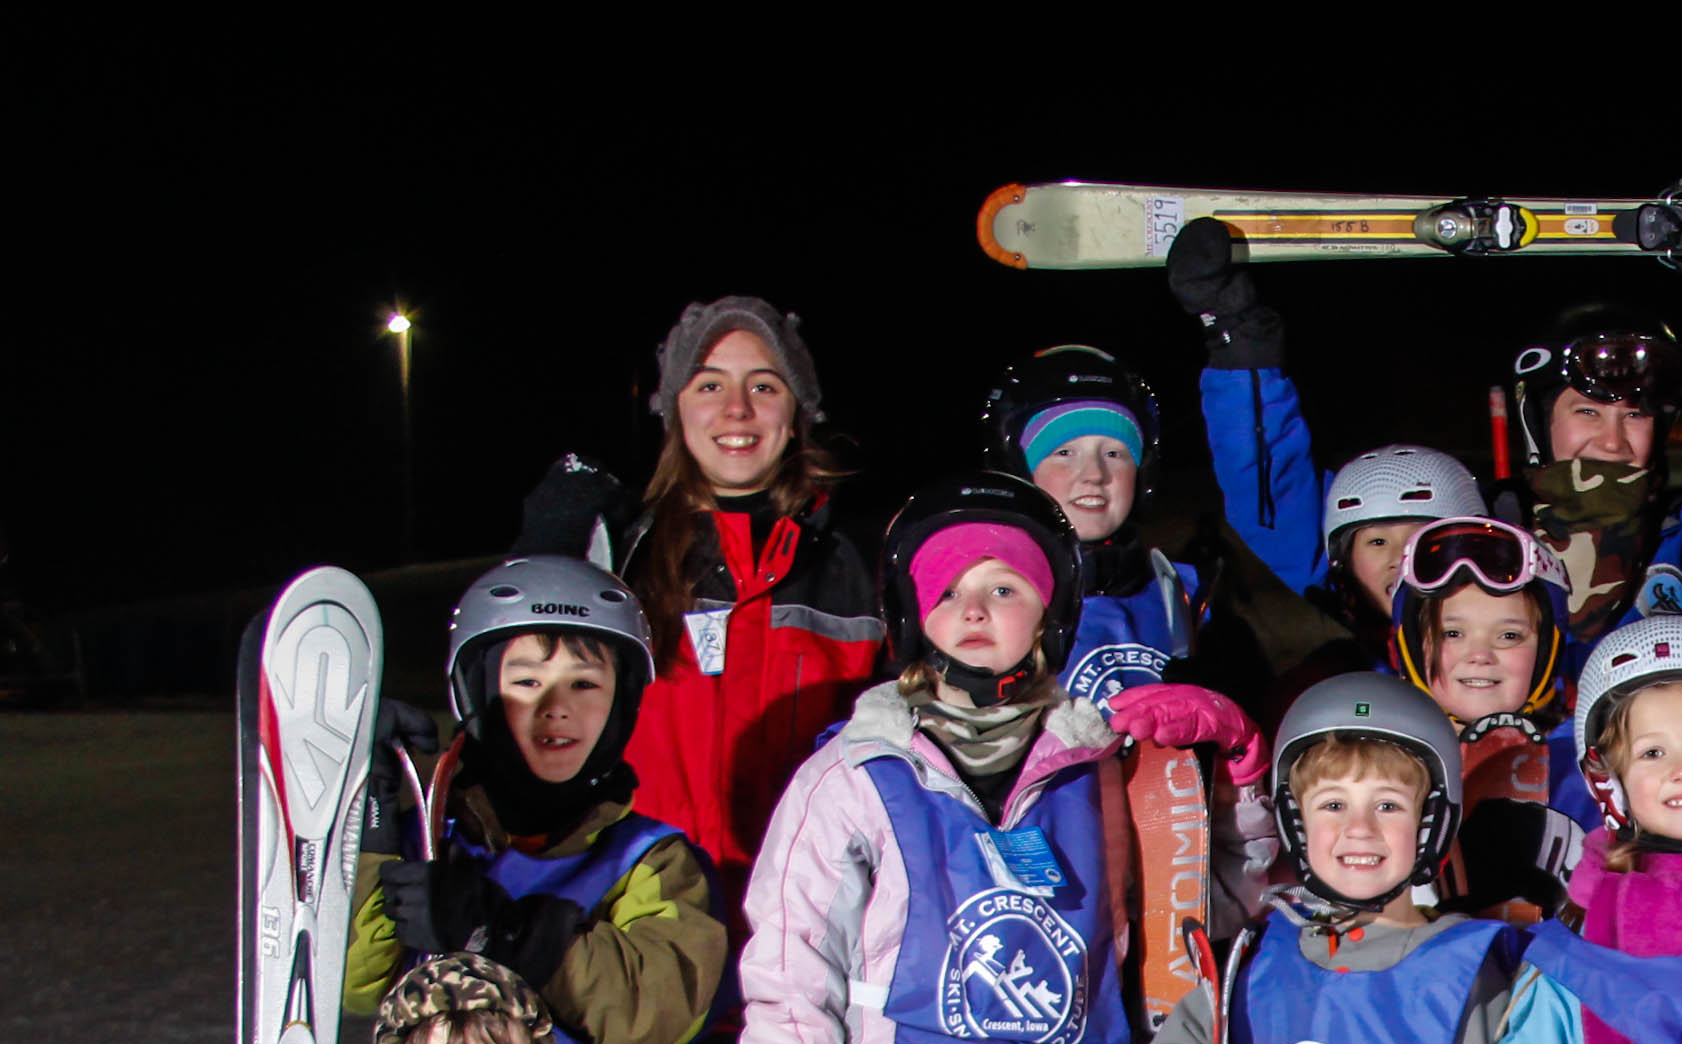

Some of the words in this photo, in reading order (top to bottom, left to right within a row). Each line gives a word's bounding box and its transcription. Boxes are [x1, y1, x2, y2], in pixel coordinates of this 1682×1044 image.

[1101, 650, 1167, 672] CRESC
[977, 894, 1081, 957] CRESCENT
[1026, 1019, 1049, 1032] Iowa
